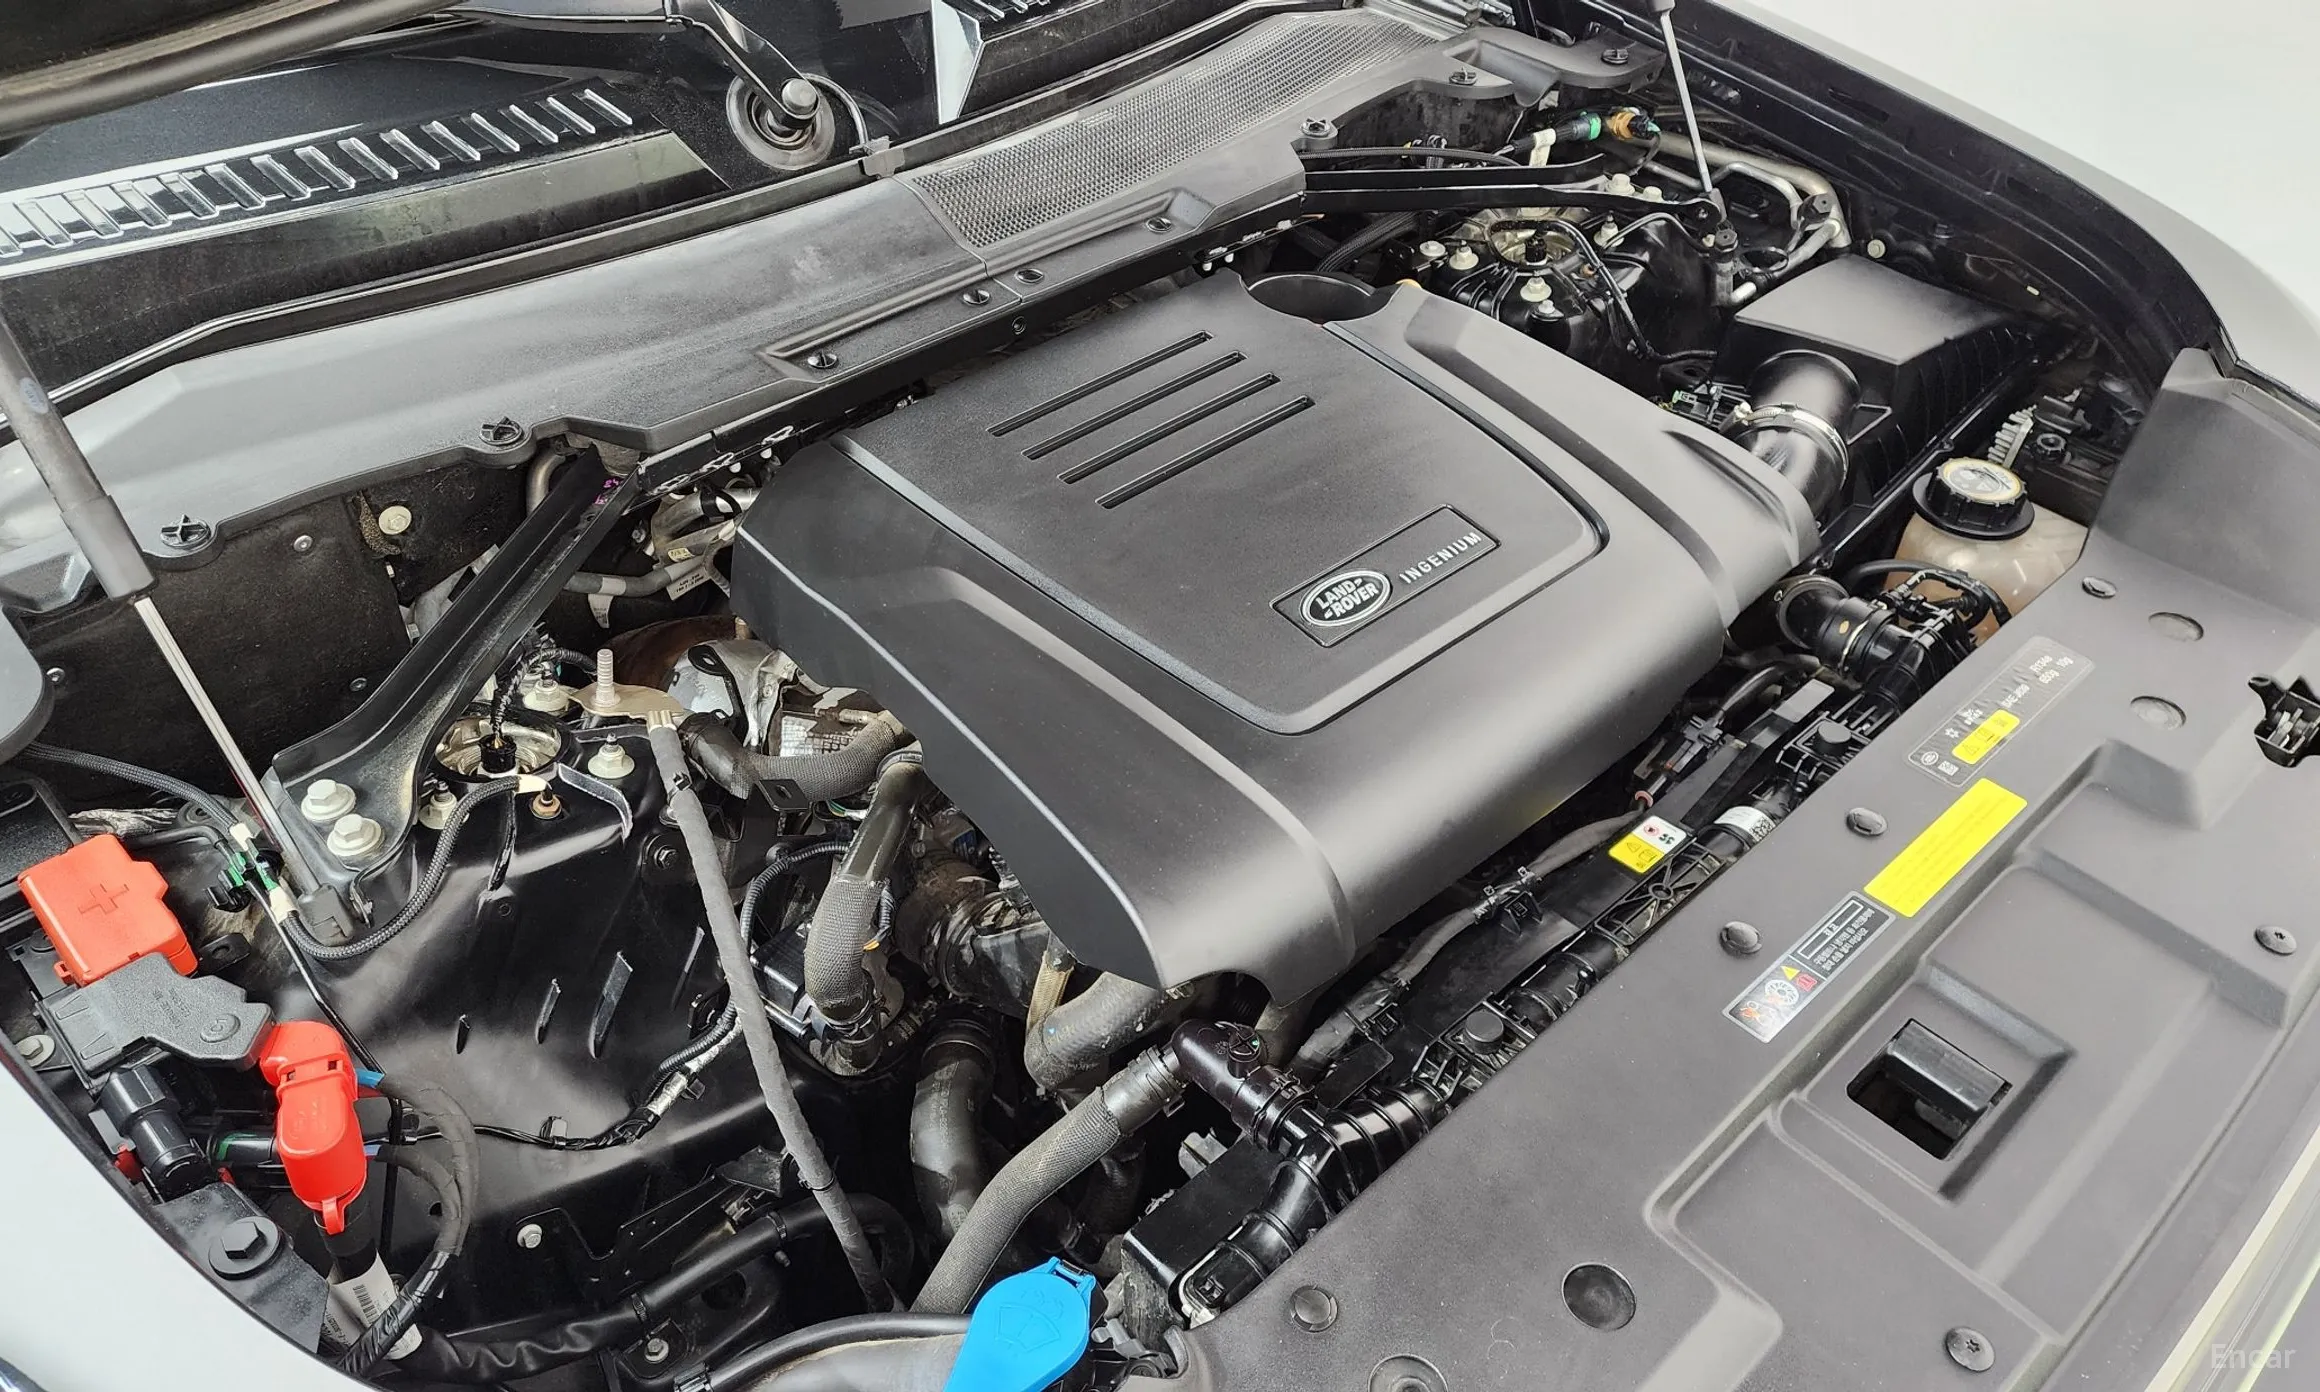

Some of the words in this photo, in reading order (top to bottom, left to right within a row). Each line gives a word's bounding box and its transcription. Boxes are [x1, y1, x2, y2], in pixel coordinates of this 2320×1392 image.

[1399, 532, 1482, 584] INGENIUM
[1315, 578, 1357, 610] LAND
[1330, 582, 1379, 617] ROVER
